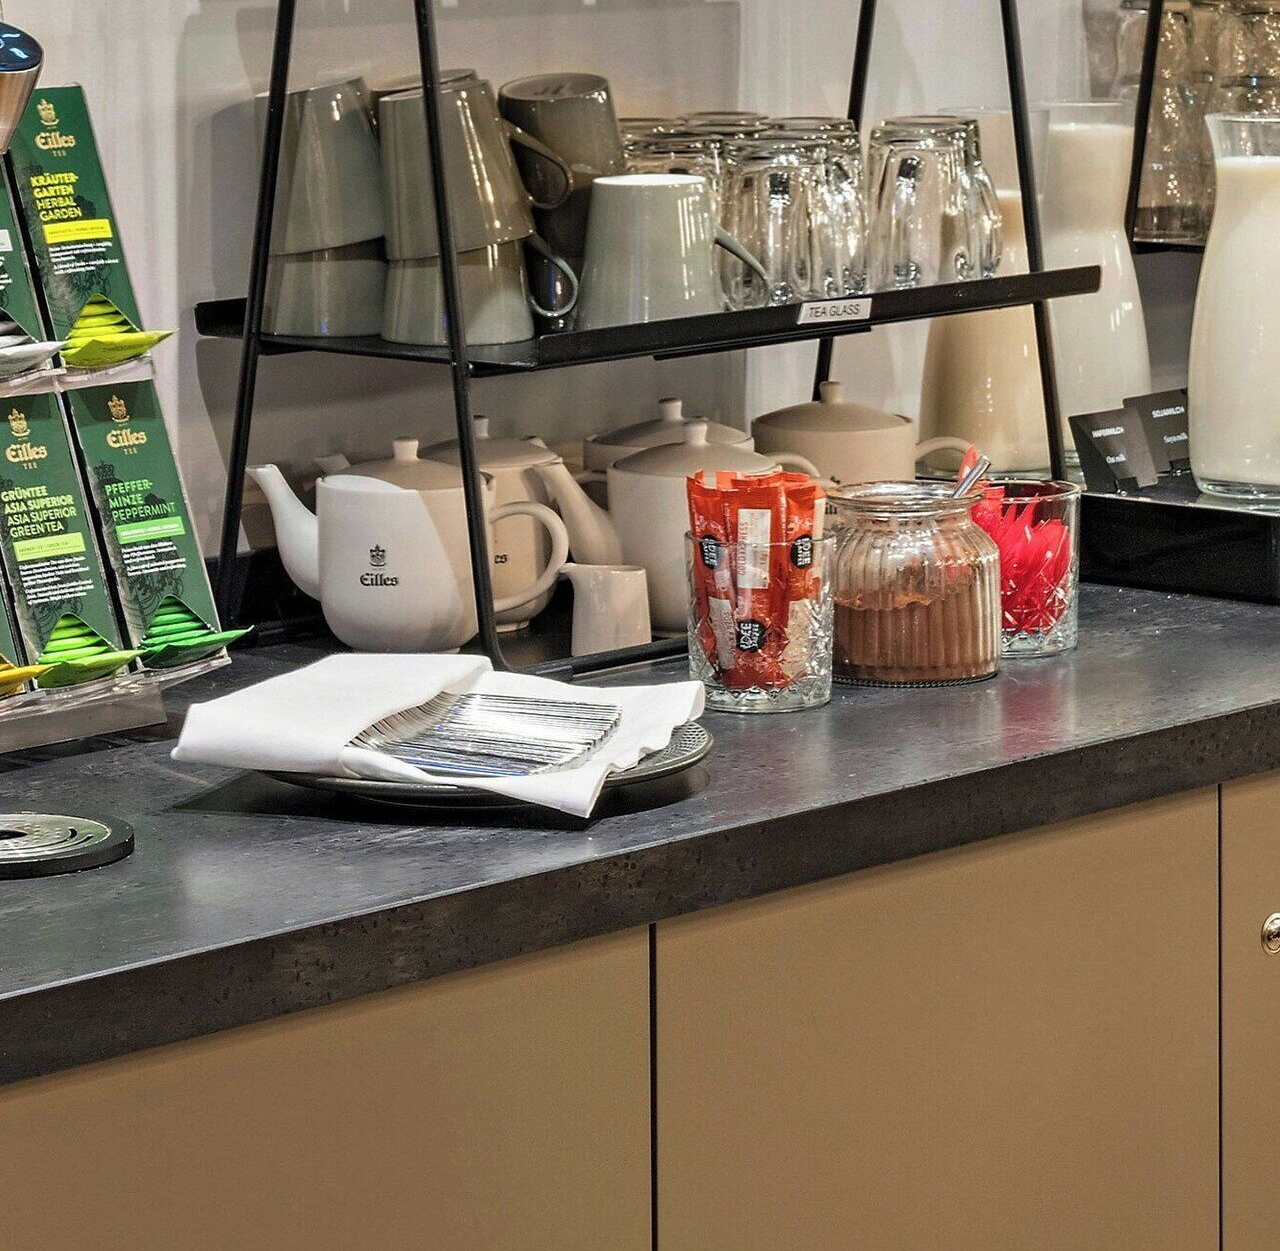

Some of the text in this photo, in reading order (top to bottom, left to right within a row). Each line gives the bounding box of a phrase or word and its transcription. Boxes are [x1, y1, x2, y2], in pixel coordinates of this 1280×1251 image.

[35, 131, 76, 149] Eilles
[30, 172, 79, 188] KRÄUTER-
[33, 185, 74, 199] GARTEN
[36, 196, 77, 211] HERBAL
[40, 207, 82, 221] GARDEN
[810, 303, 859, 317] TEA GLASS
[106, 428, 147, 448] Eilles
[5, 442, 48, 463] Eilles
[22, 462, 38, 470] TEE
[0, 485, 48, 503] GRÜNTEE
[104, 479, 153, 496] PFEFFER-
[4, 494, 74, 515] ASIA SUPERIOR
[108, 493, 145, 509] MINZE
[7, 507, 77, 527] ASIA SUPERIOR
[112, 502, 176, 522] PEPPERMINT
[9, 521, 65, 538] GREEN TEA
[359, 572, 399, 587] Eilles
